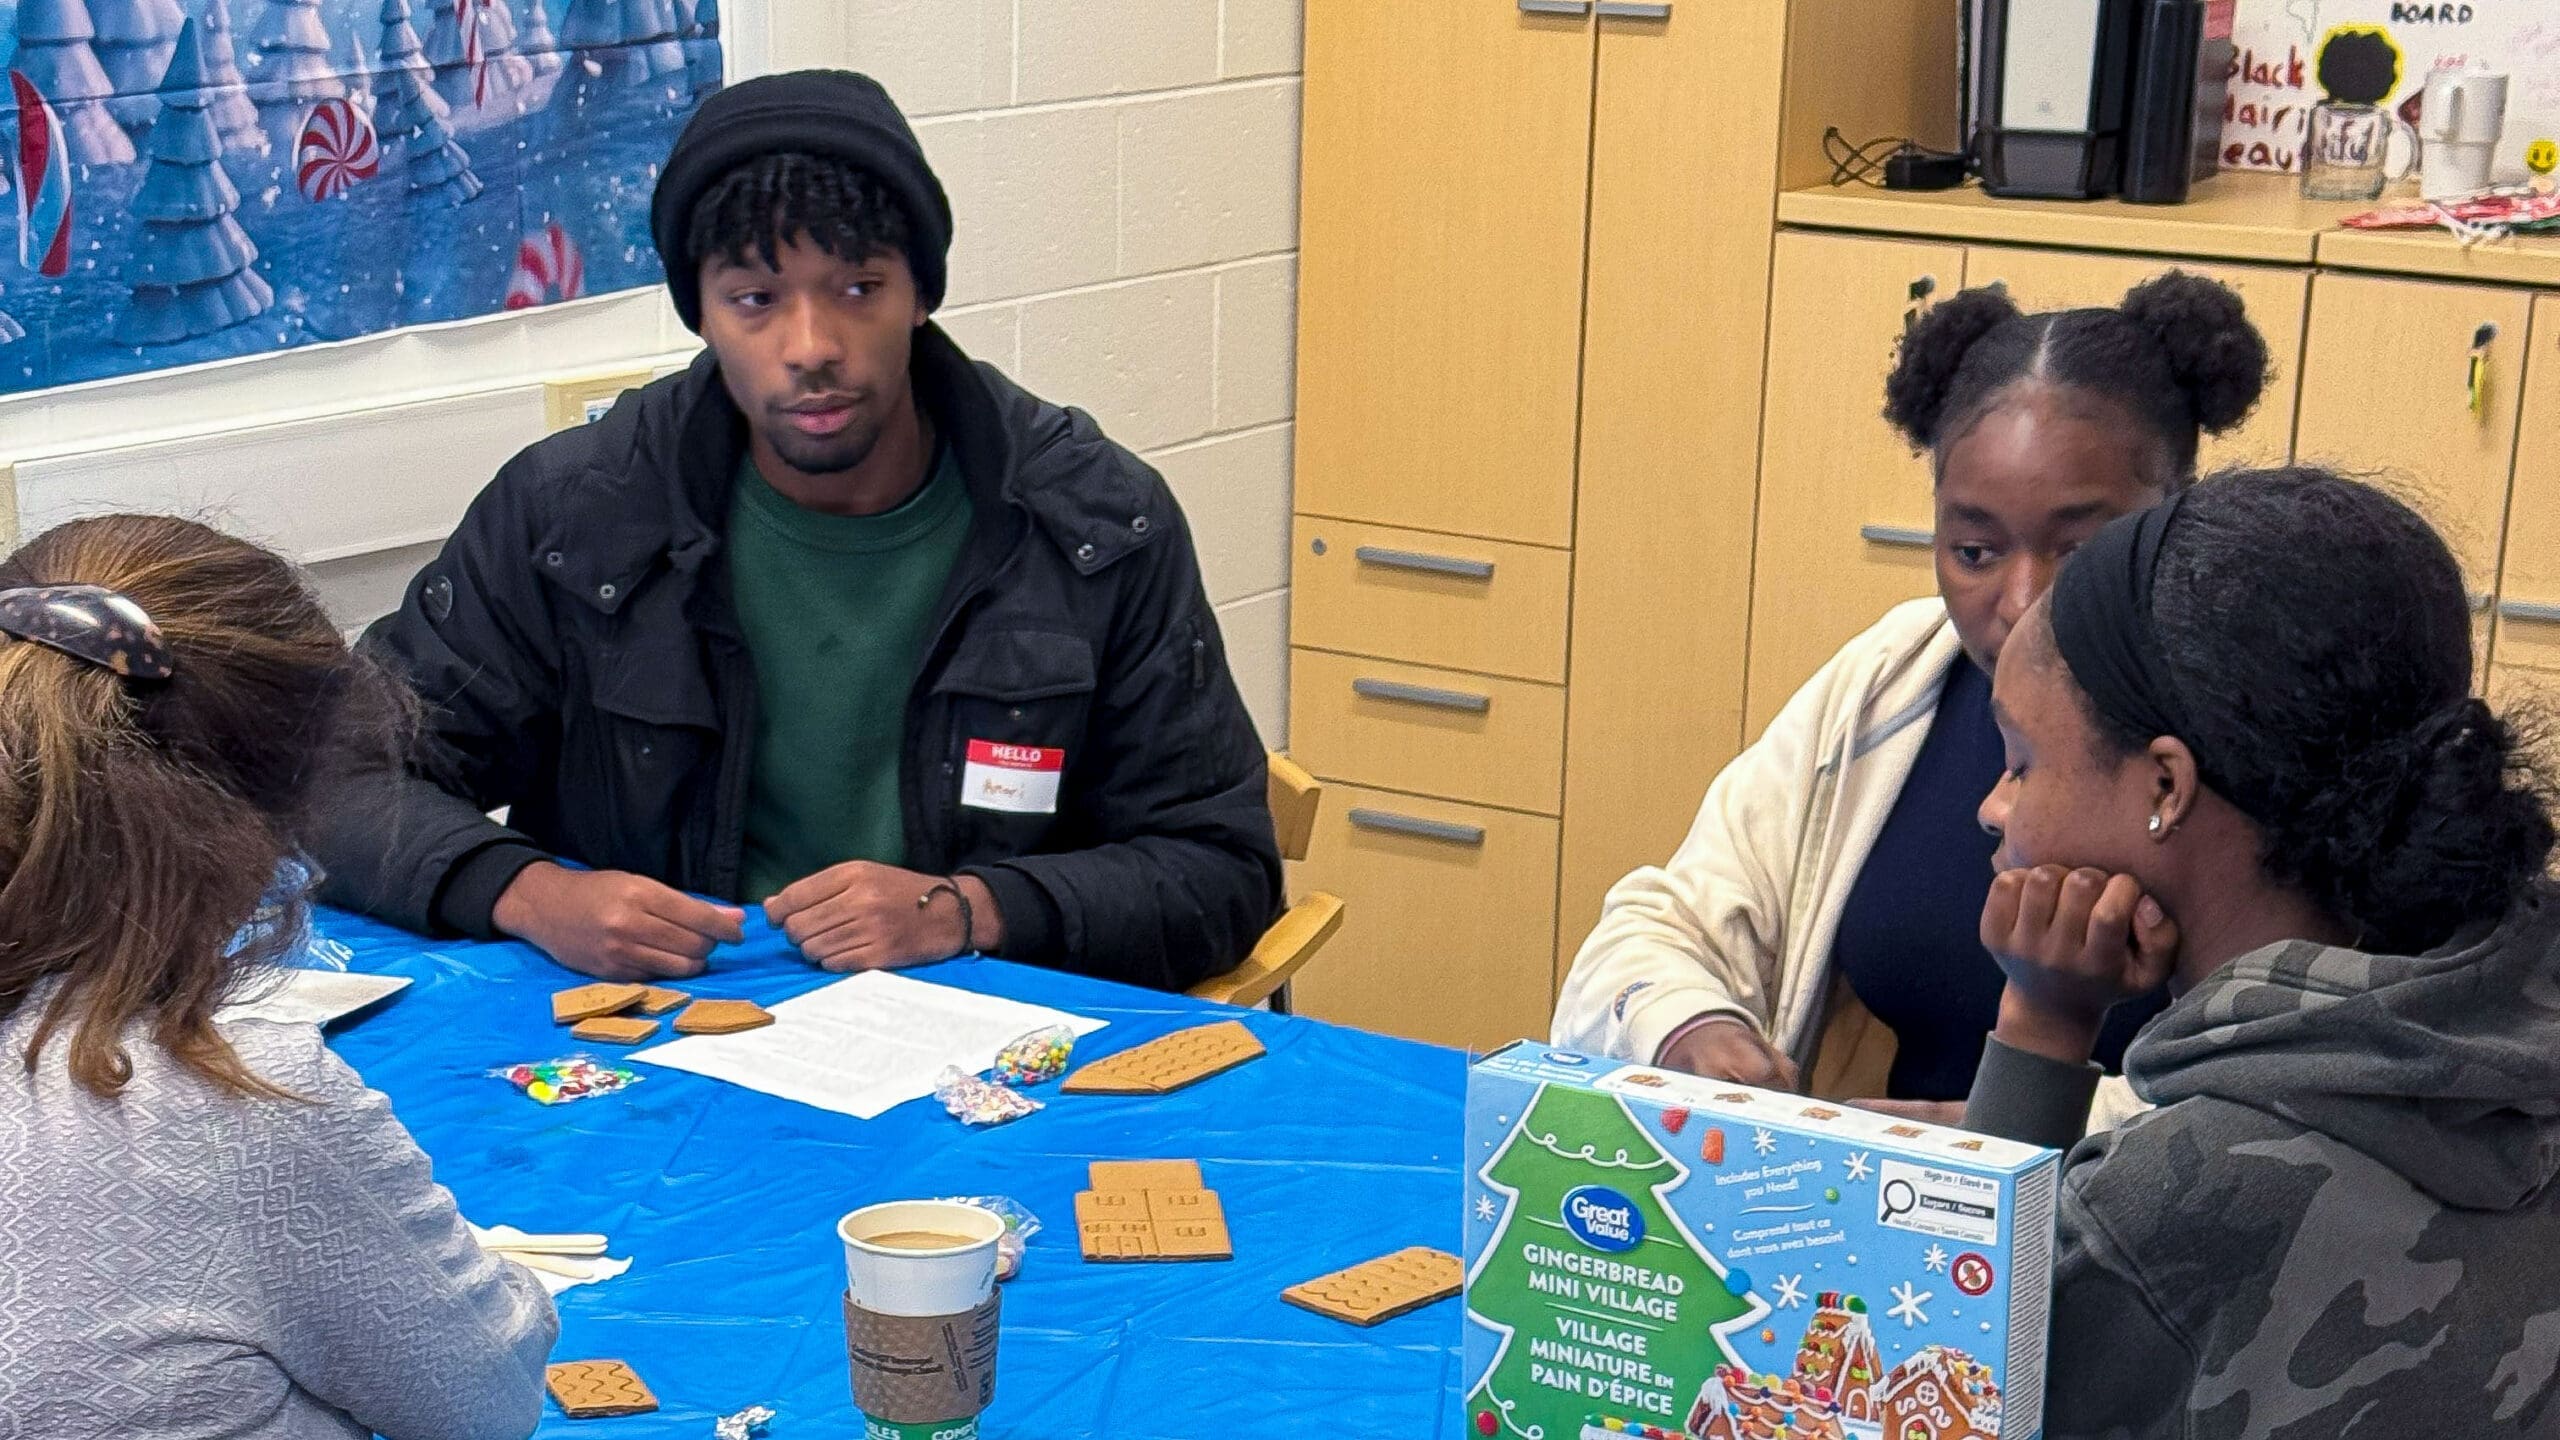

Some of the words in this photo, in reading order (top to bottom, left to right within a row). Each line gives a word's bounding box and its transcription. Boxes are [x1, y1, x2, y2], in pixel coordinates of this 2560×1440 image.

[2391, 3, 2473, 24] BOARD
[991, 745, 1041, 762] HELLO
[1762, 1160, 1822, 1177] Everything
[1572, 1196, 1630, 1228] Great
[1585, 1219, 1629, 1242] Value
[1733, 1224, 1790, 1241] Comprend
[1523, 1243, 1684, 1296] GINGERBREAD
[1528, 1270, 1579, 1299] MINI
[1585, 1283, 1678, 1322] VILLAGE
[1556, 1317, 1647, 1356] VILLAGE
[1530, 1337, 1652, 1385] MINIATURE
[1654, 1373, 1674, 1389] EN
[1531, 1363, 1581, 1393] PAIN
[1588, 1377, 1673, 1416] D'ÉPICE
